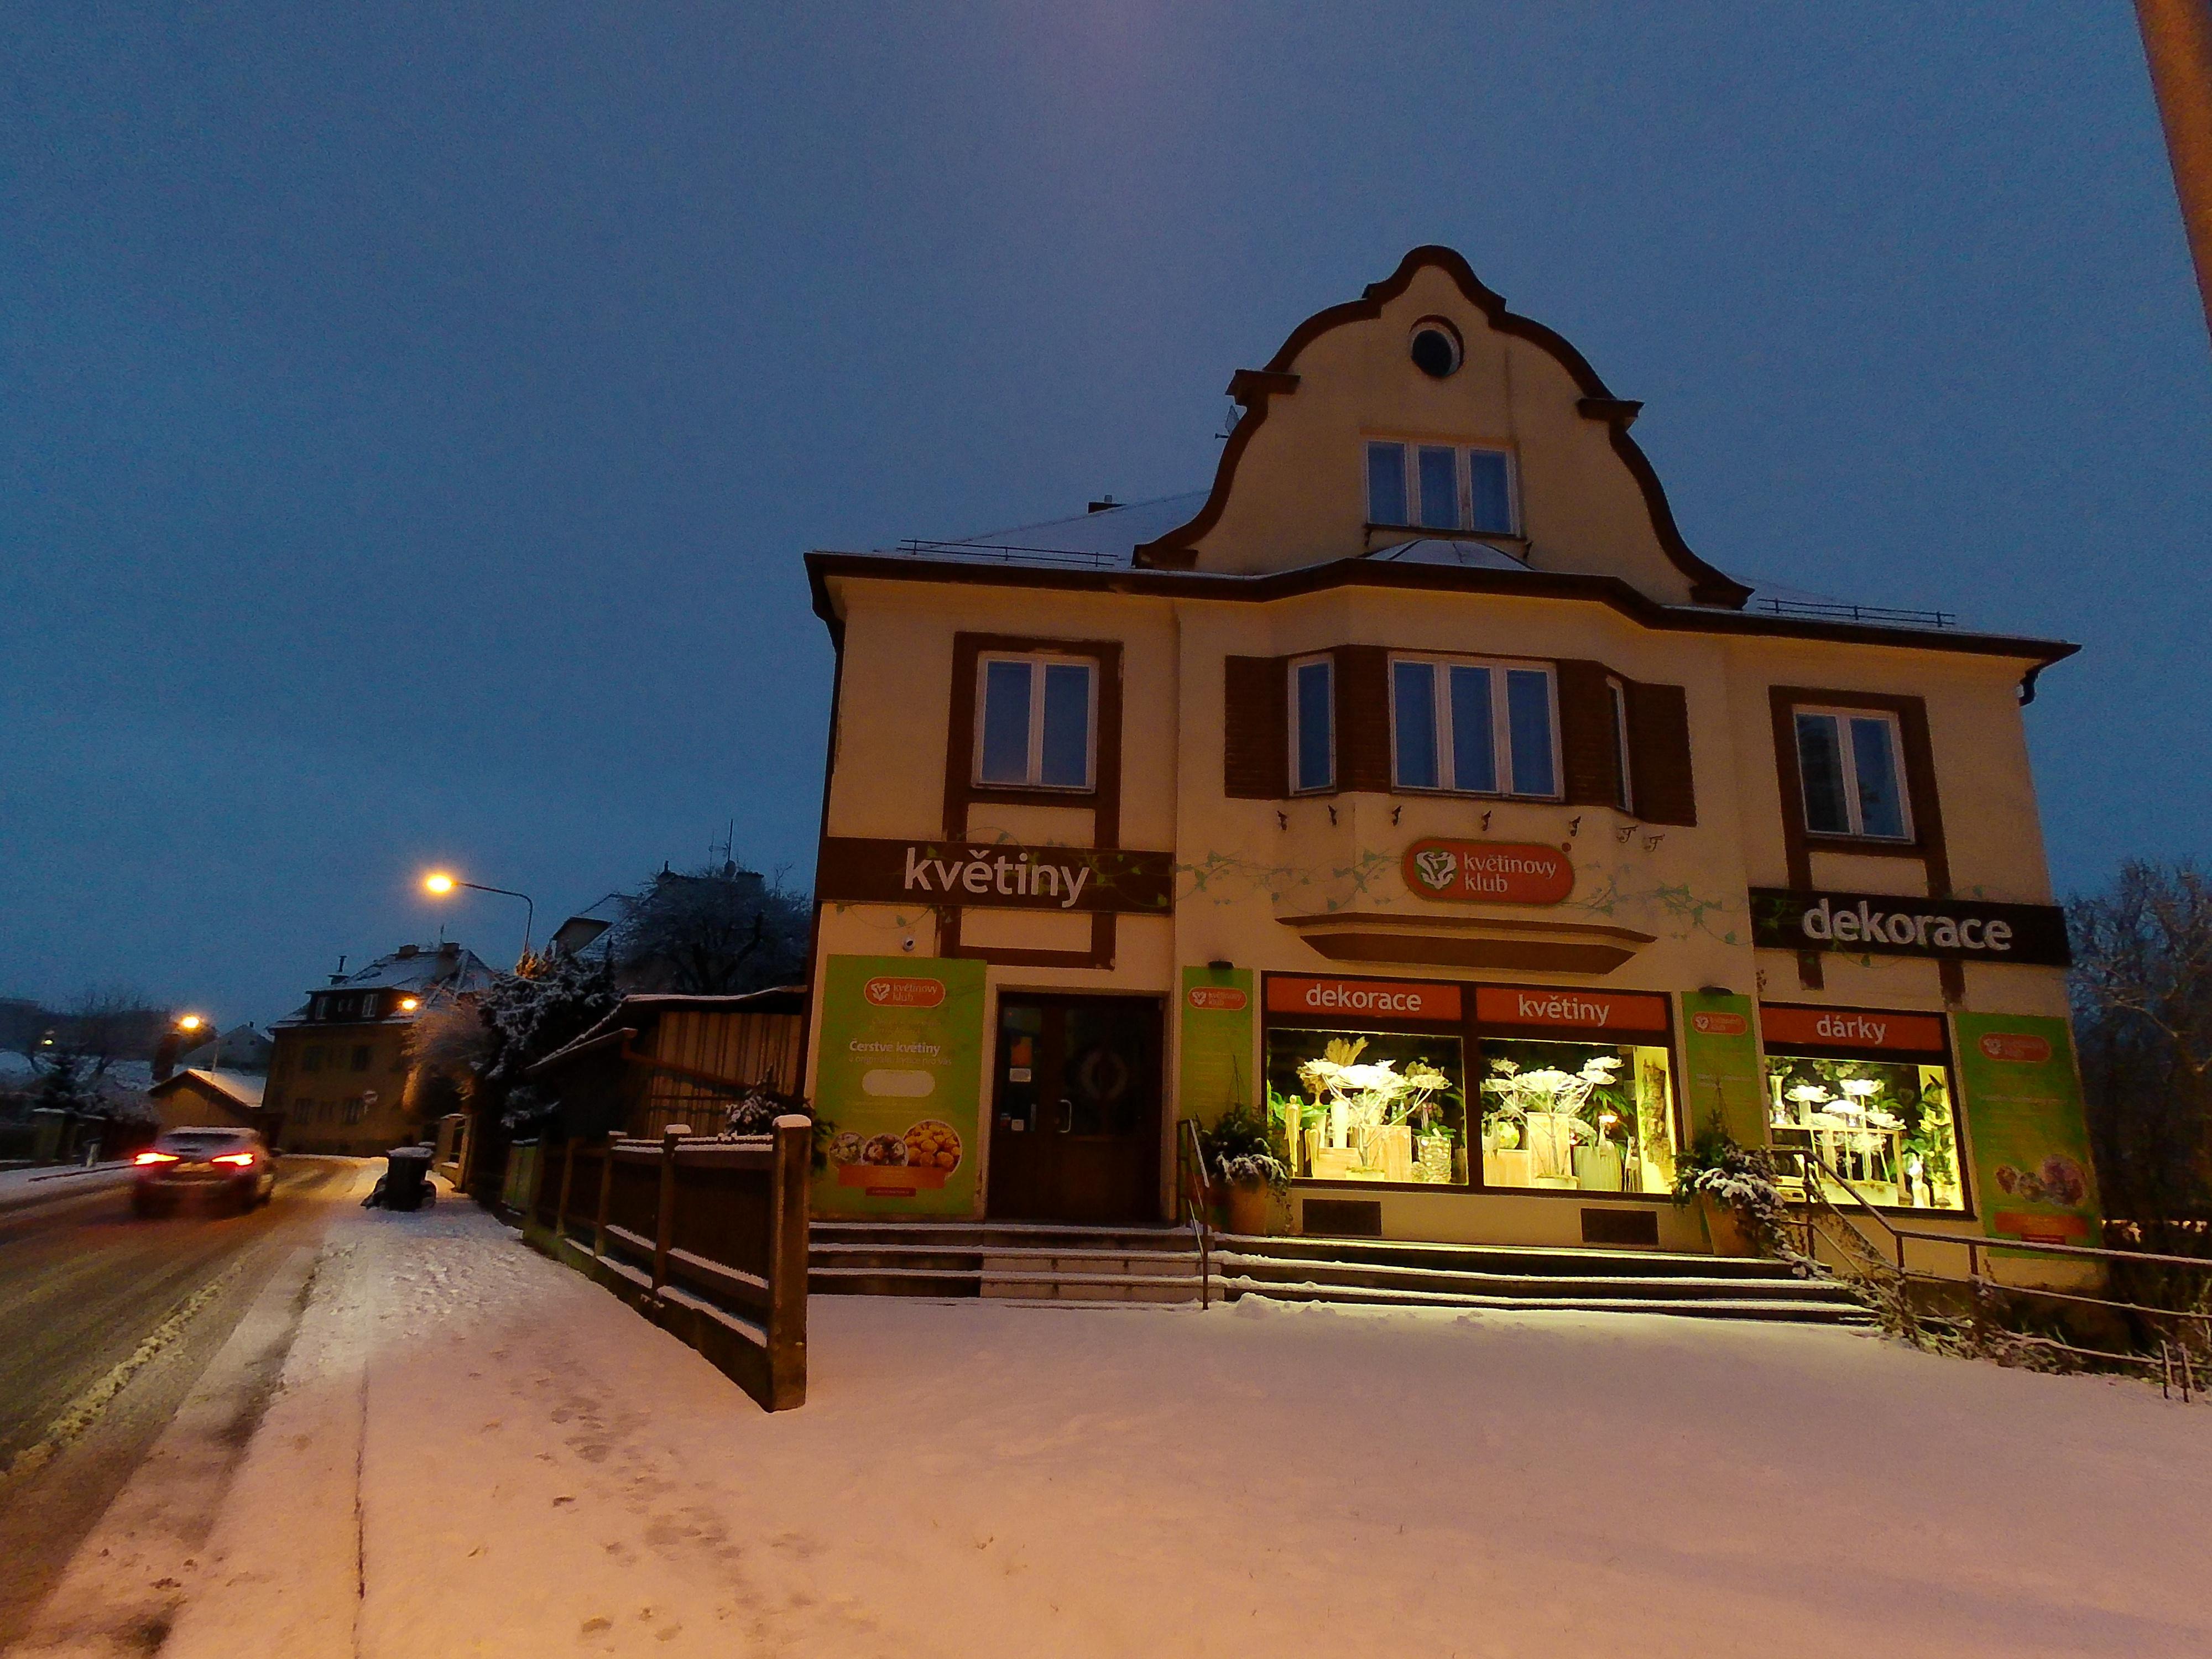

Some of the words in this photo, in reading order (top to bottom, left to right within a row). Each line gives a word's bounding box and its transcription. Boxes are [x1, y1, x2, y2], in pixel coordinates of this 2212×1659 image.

[904, 847, 1089, 908] květiny
[1464, 872, 1509, 893] klub
[1802, 898, 2013, 951] dekorace
[1305, 983, 1422, 1012] dekorace
[1518, 994, 1610, 1027] květiny
[1816, 1015, 1886, 1045] dárky
